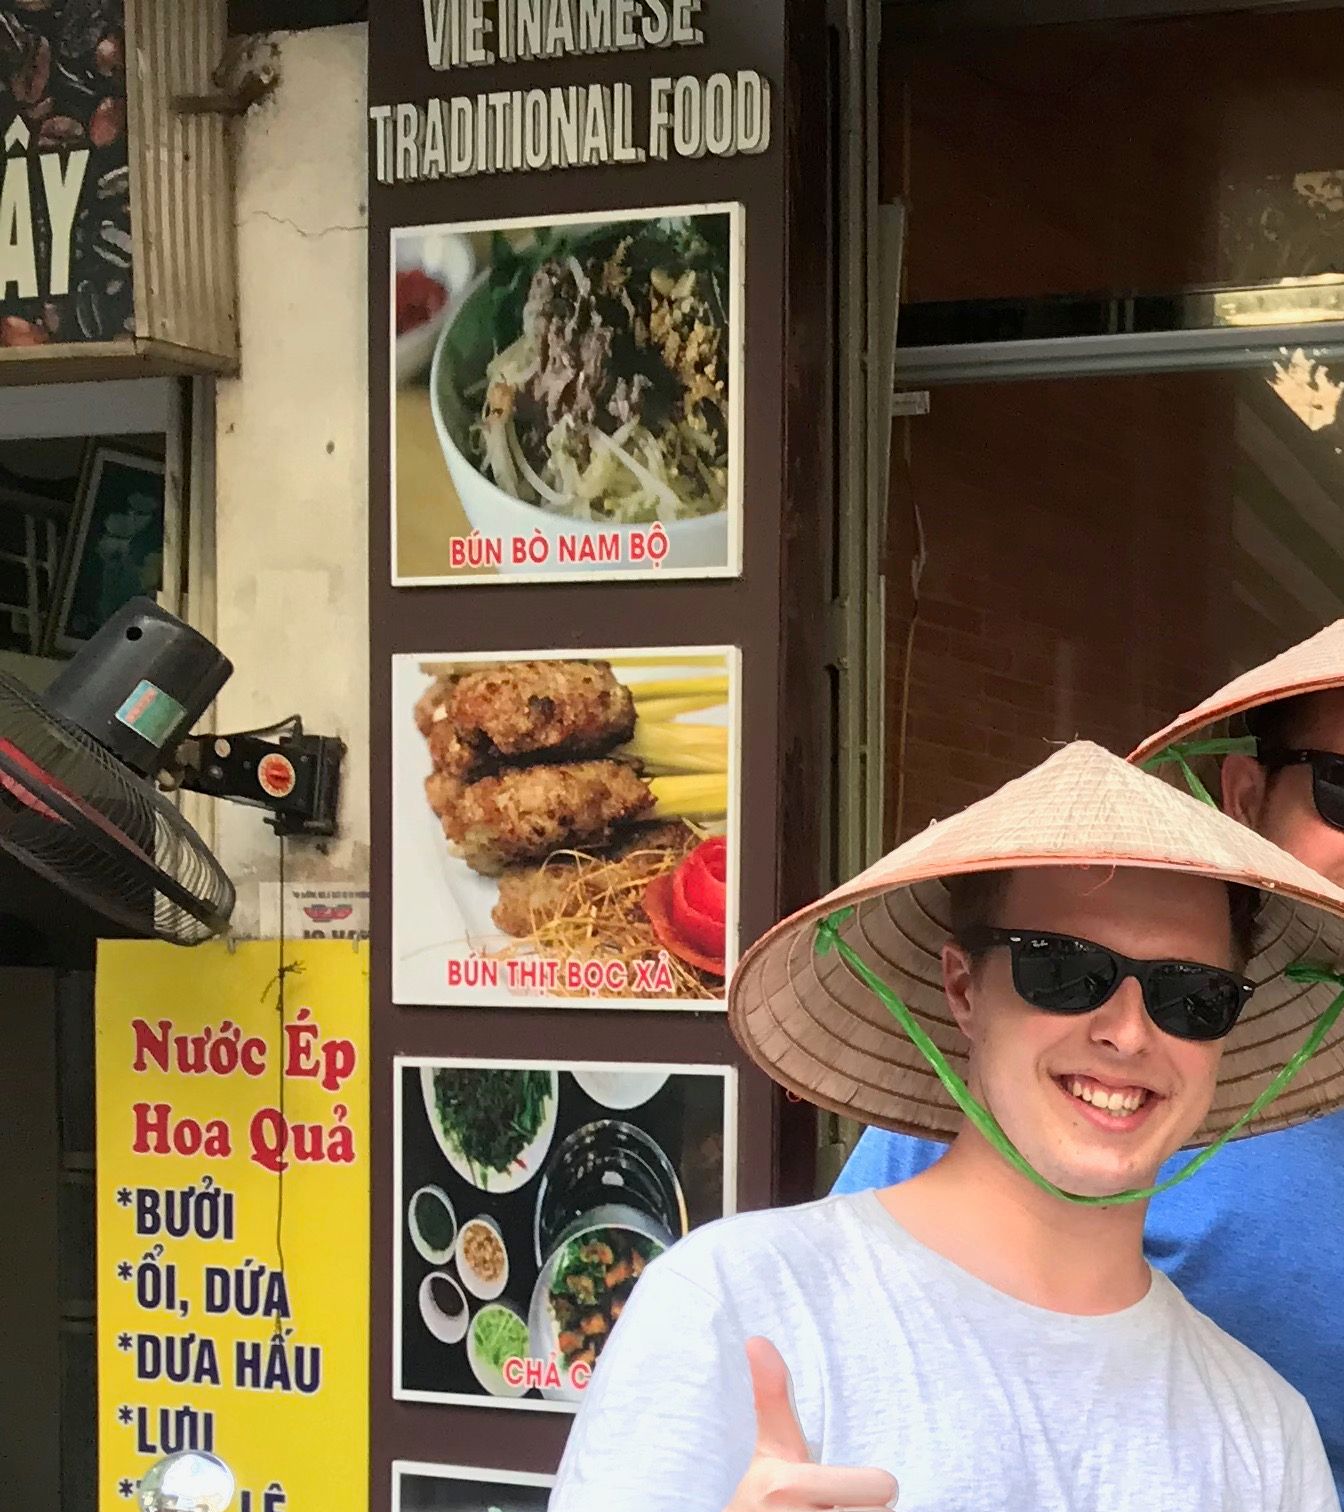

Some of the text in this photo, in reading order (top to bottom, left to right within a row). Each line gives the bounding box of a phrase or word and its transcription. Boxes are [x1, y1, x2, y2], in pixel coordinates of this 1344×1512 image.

[423, 0, 704, 70] VIETNAMESE
[369, 70, 771, 184] TRADITIONAL FOOD
[450, 521, 670, 569] BÚN BÒ NAM BỘ
[447, 950, 675, 997] BÚN THỊT BỌC XẢ
[131, 1008, 356, 1091] Nước Ép
[132, 1102, 356, 1173] Hoa Quả
[205, 1259, 291, 1318] DỨA
[235, 1329, 321, 1394] HẤU
[503, 1351, 561, 1388] CHẢ
